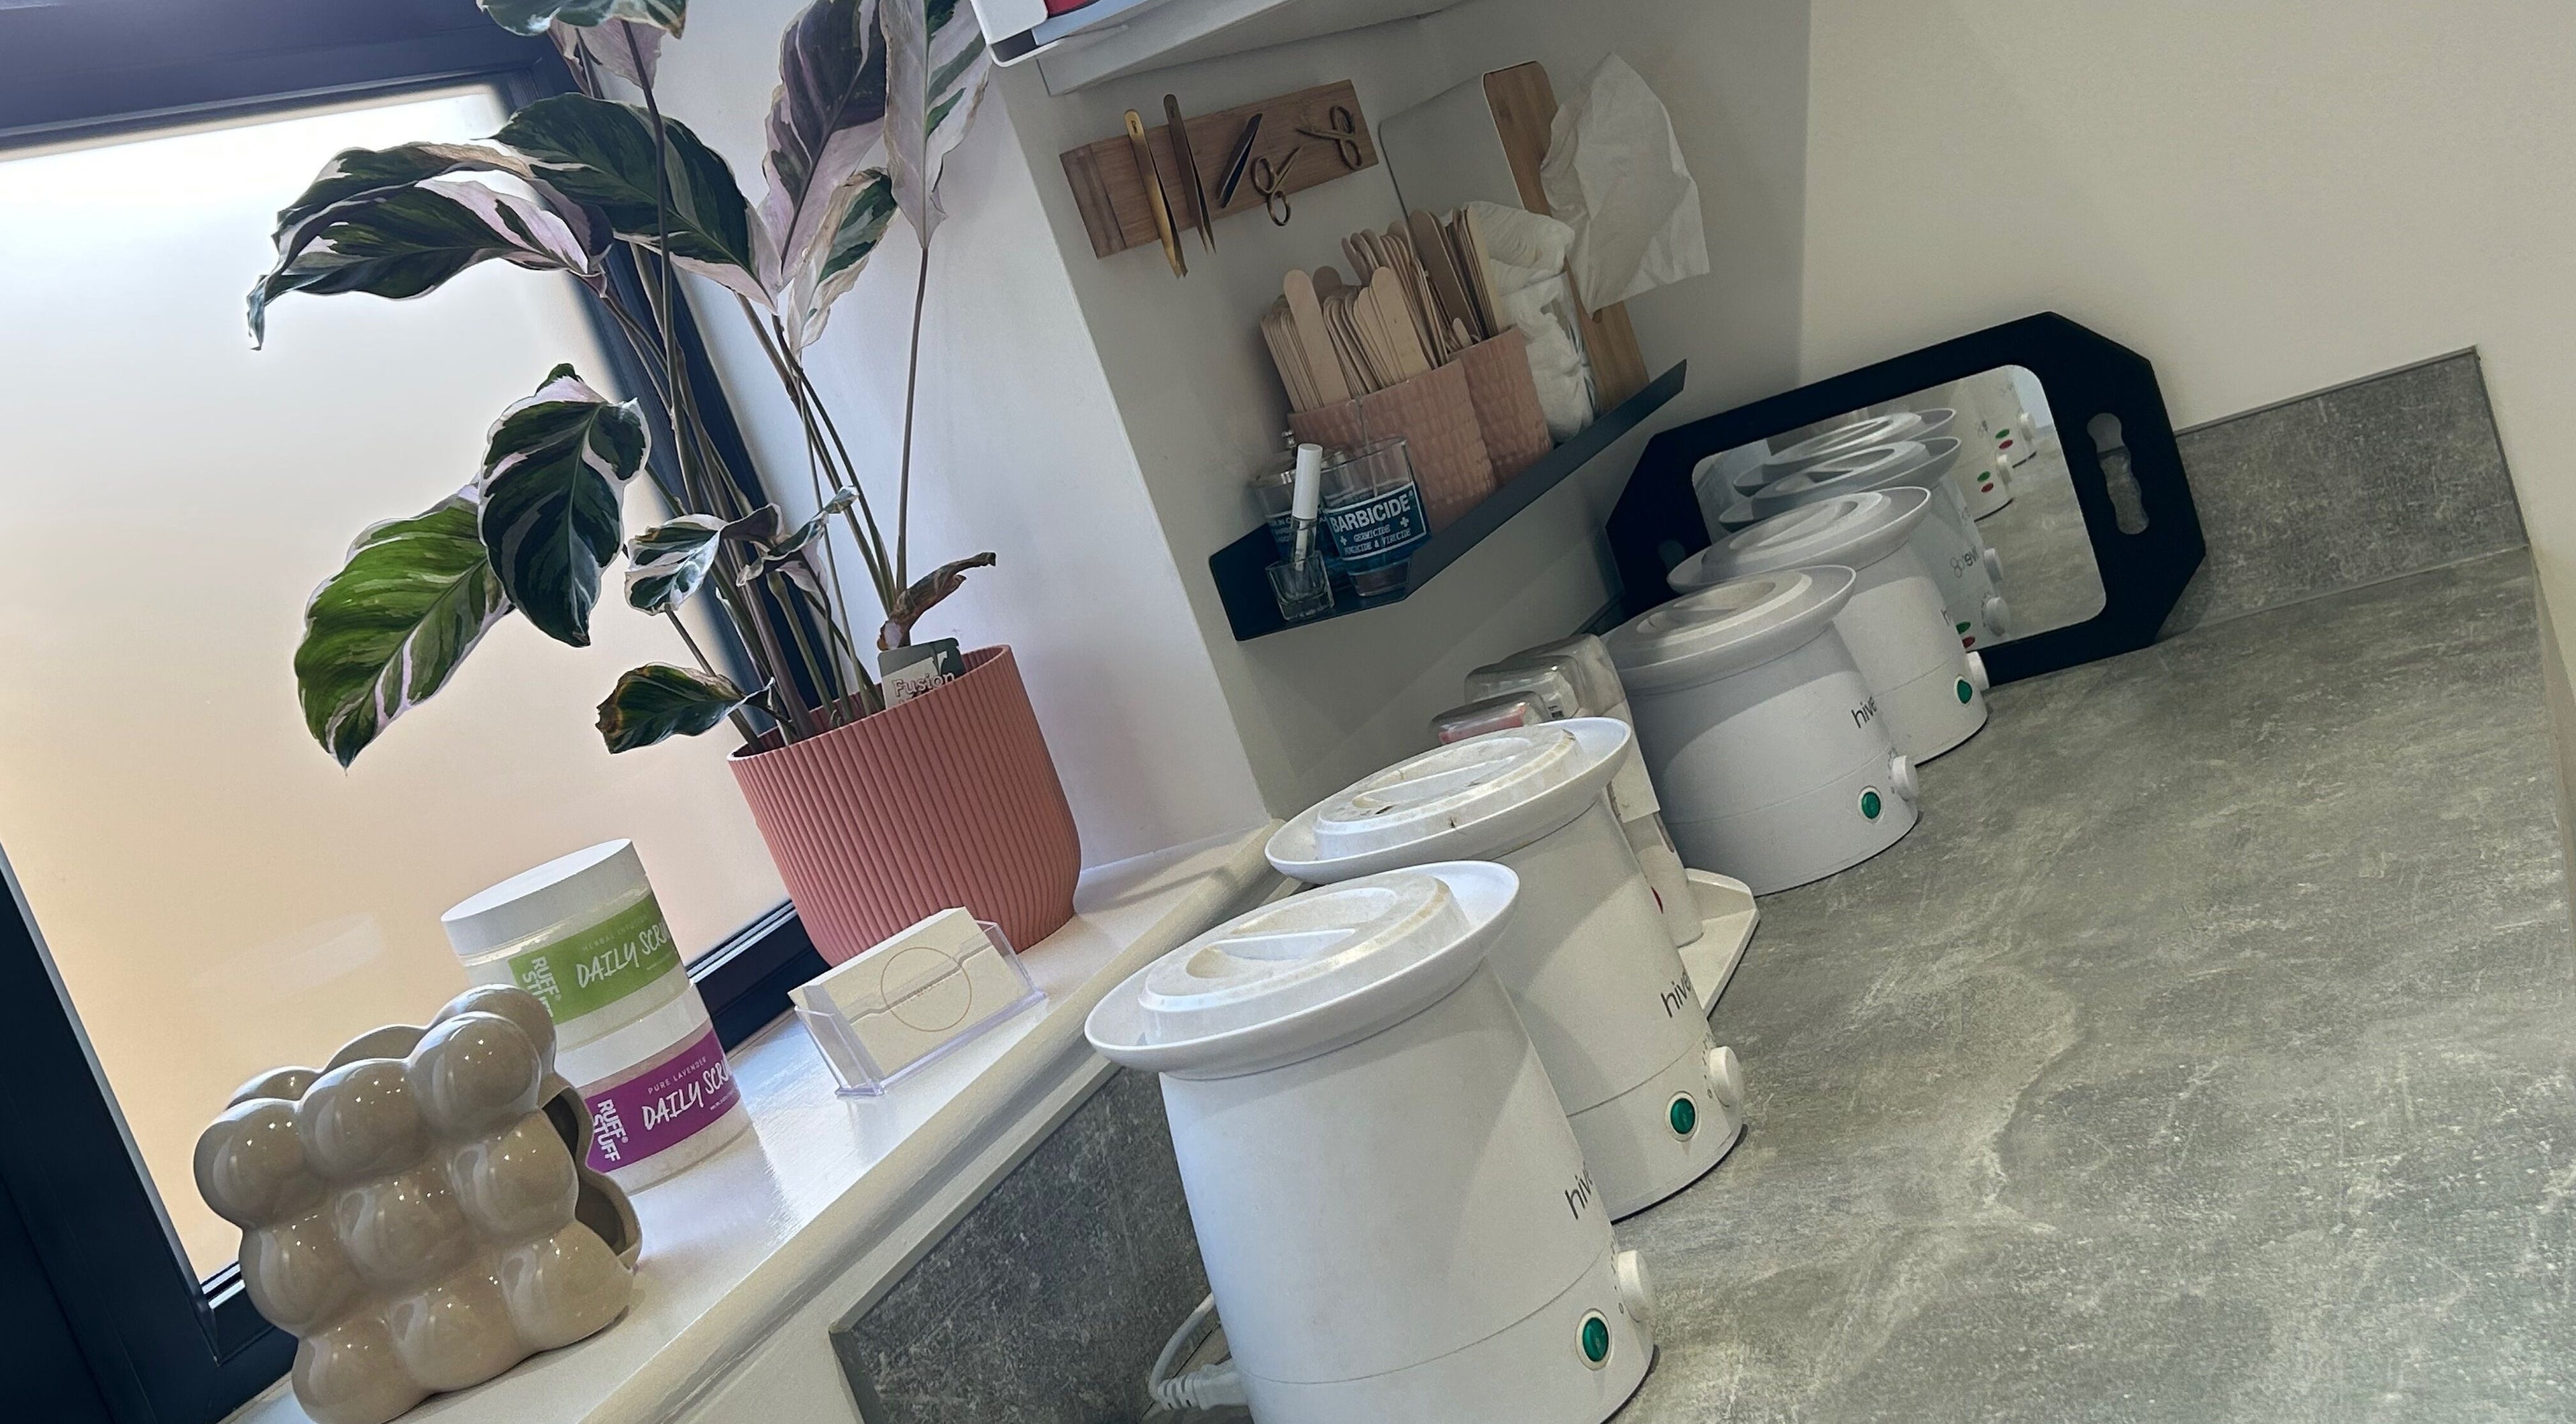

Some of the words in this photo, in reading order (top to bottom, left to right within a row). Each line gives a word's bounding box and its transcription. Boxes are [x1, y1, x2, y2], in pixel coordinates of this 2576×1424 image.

[1330, 494, 1410, 533] BARBICIDE
[892, 672, 955, 698] Fusion
[576, 941, 640, 988] DAILY
[639, 917, 671, 955] SCRU
[531, 956, 560, 997] RUFF
[1660, 970, 1691, 1018] hive
[641, 1081, 704, 1130] DAILY
[702, 1057, 731, 1095] SCRU
[648, 1078, 672, 1095] PURE
[672, 1056, 707, 1082] LAVENDER
[593, 1113, 622, 1162] STUFF
[598, 1098, 627, 1139] RUFF
